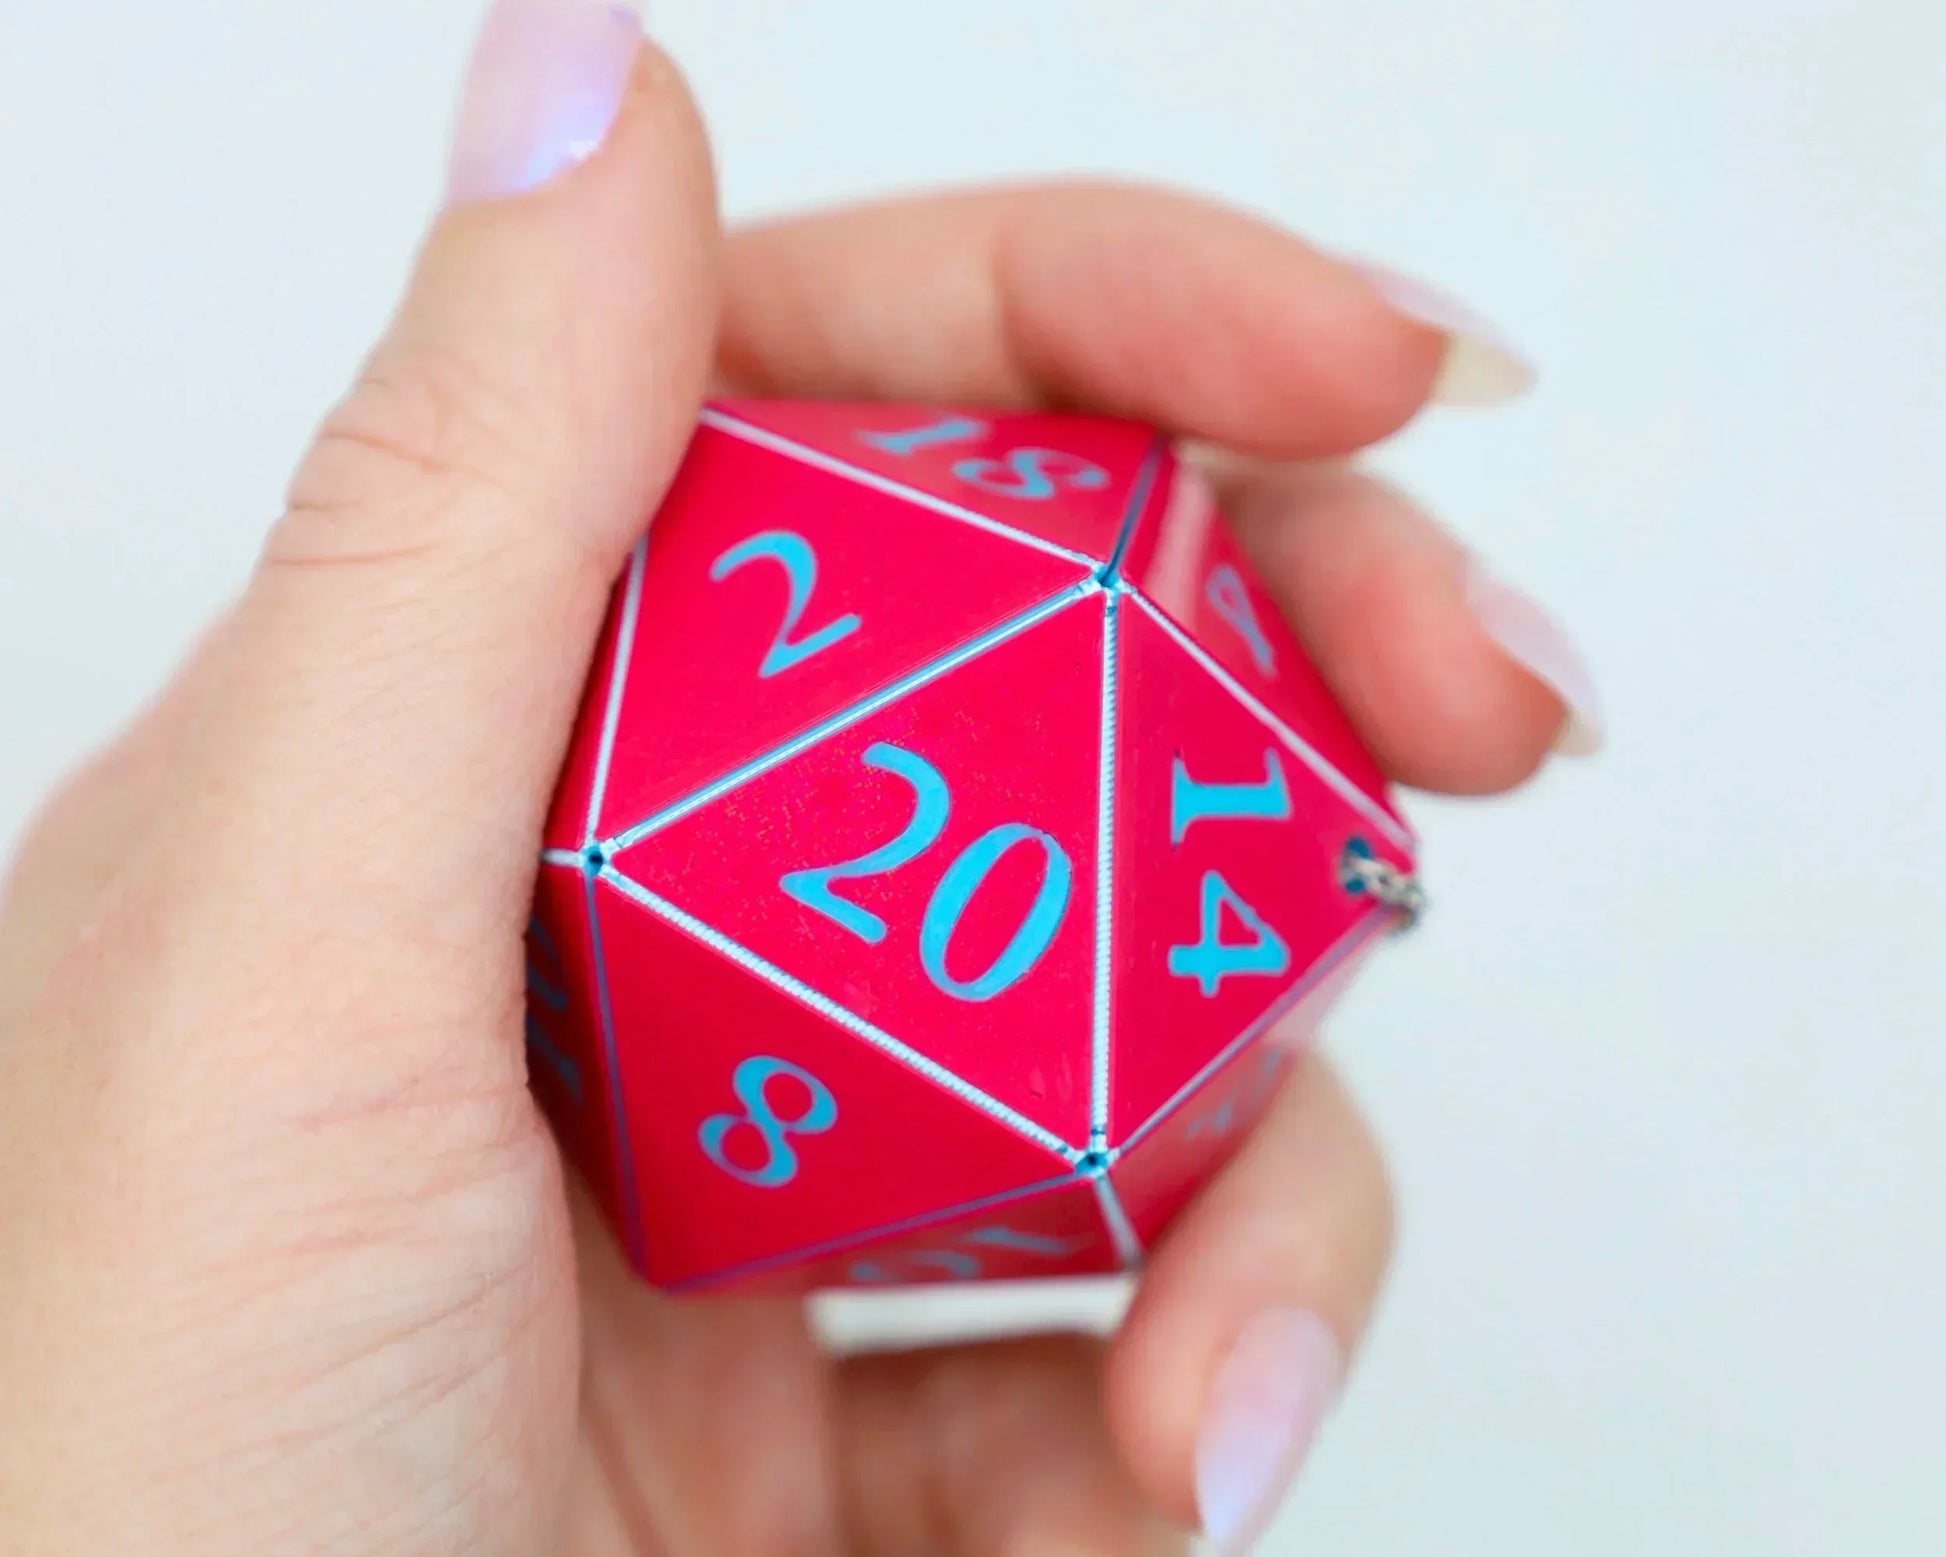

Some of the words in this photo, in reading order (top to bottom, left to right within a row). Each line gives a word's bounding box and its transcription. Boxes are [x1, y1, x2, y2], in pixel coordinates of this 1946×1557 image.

[856, 416, 1110, 500] 18
[709, 529, 862, 679] 2
[779, 740, 1073, 1003] 20
[1167, 748, 1293, 998] 14
[697, 1053, 839, 1189] 8
